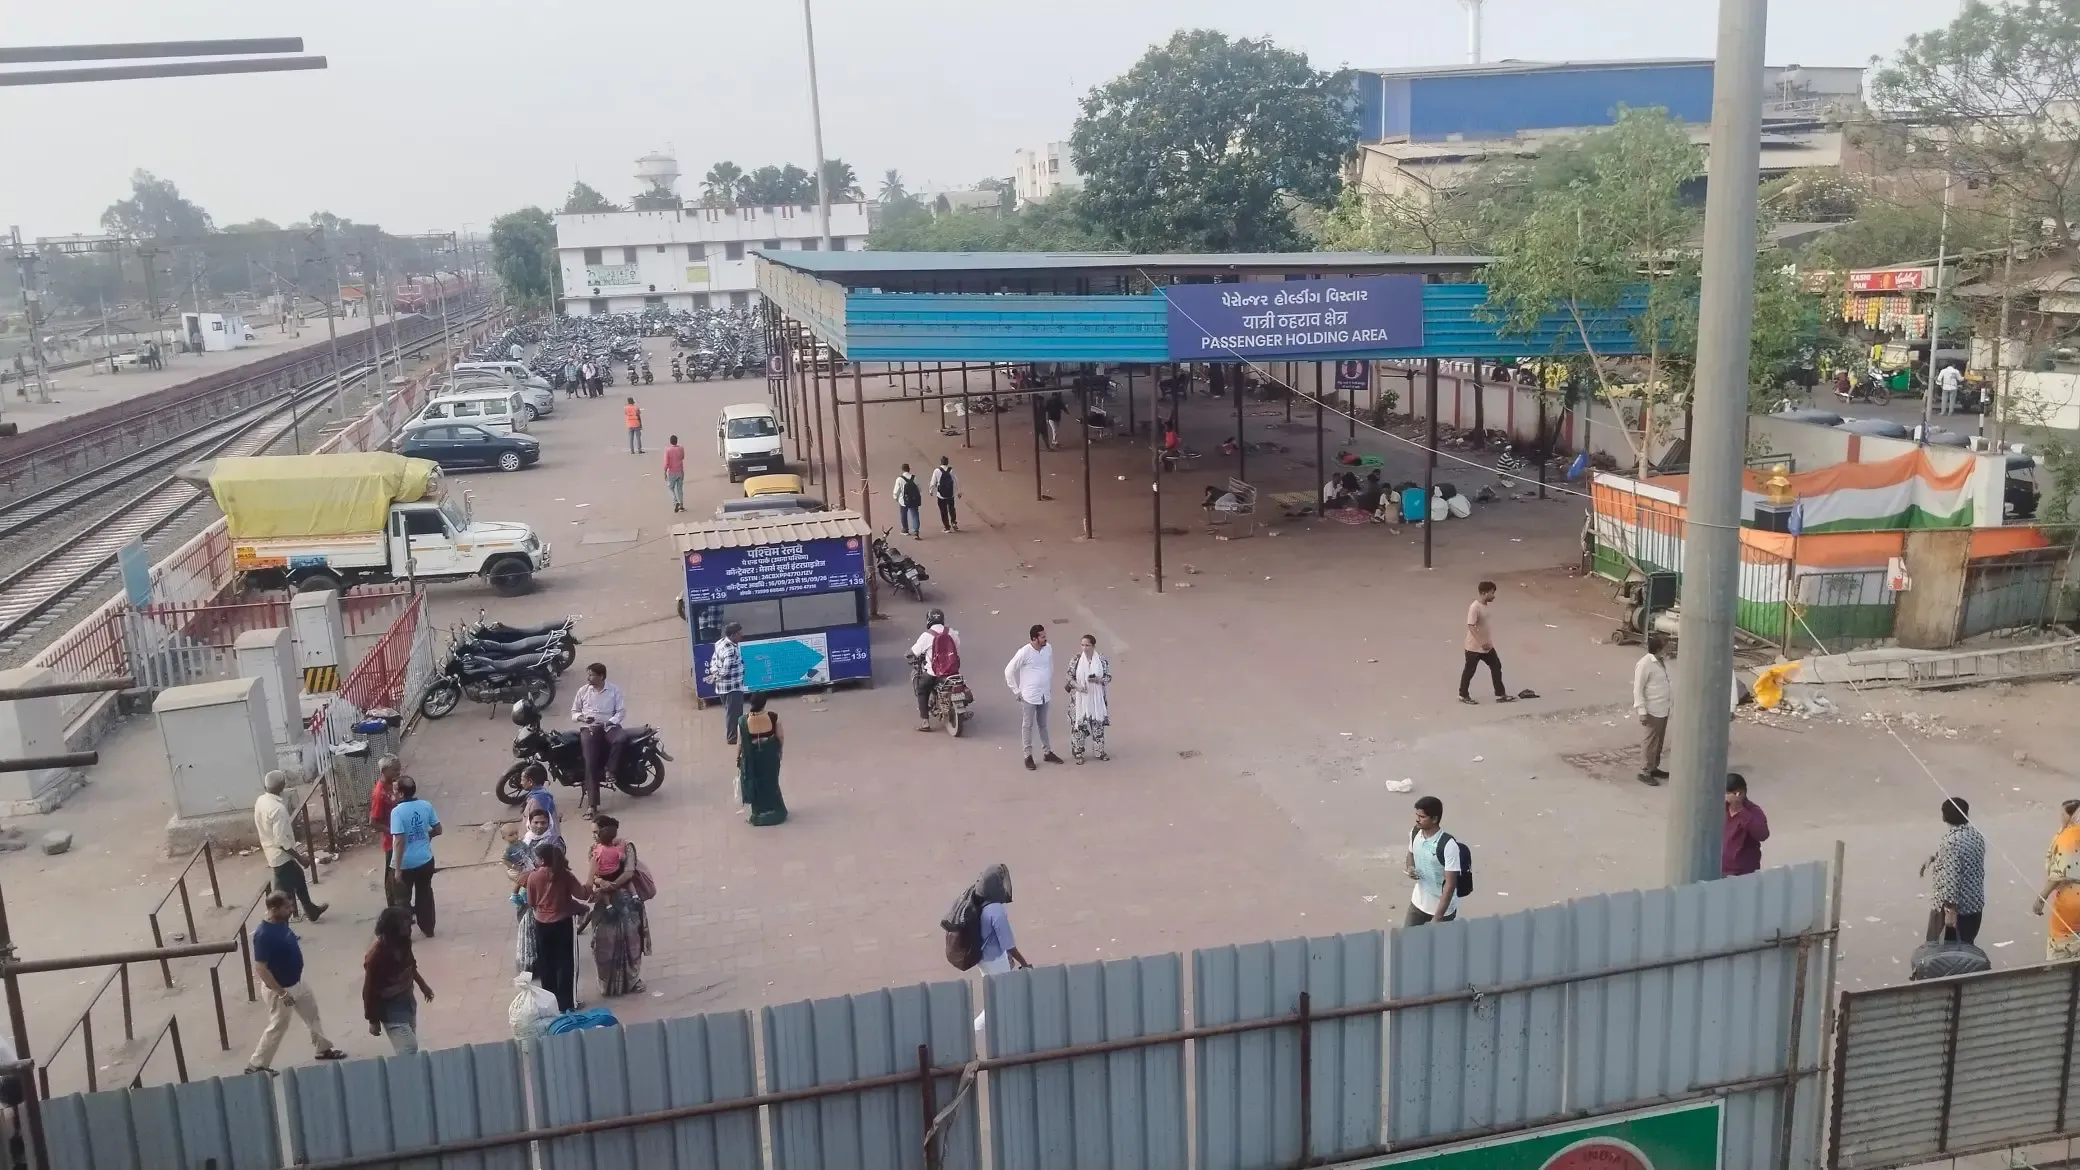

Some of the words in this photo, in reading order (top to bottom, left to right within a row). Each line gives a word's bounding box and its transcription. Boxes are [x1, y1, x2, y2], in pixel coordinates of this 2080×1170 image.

[1221, 292, 1269, 307] પેસેન્જર
[1326, 287, 1368, 303] વિસ્તાર
[1242, 310, 1275, 329] यात्री
[1277, 312, 1321, 329] ठहराव
[1324, 308, 1348, 326] क्षेत्र
[1201, 335, 1282, 349] PASSENGER
[1285, 331, 1348, 346] HOLDING
[1351, 329, 1388, 342] AREA
[747, 547, 780, 559] पश्चिम
[781, 544, 803, 555] रेलवे
[710, 591, 727, 600] 139
[851, 652, 867, 660] 139
